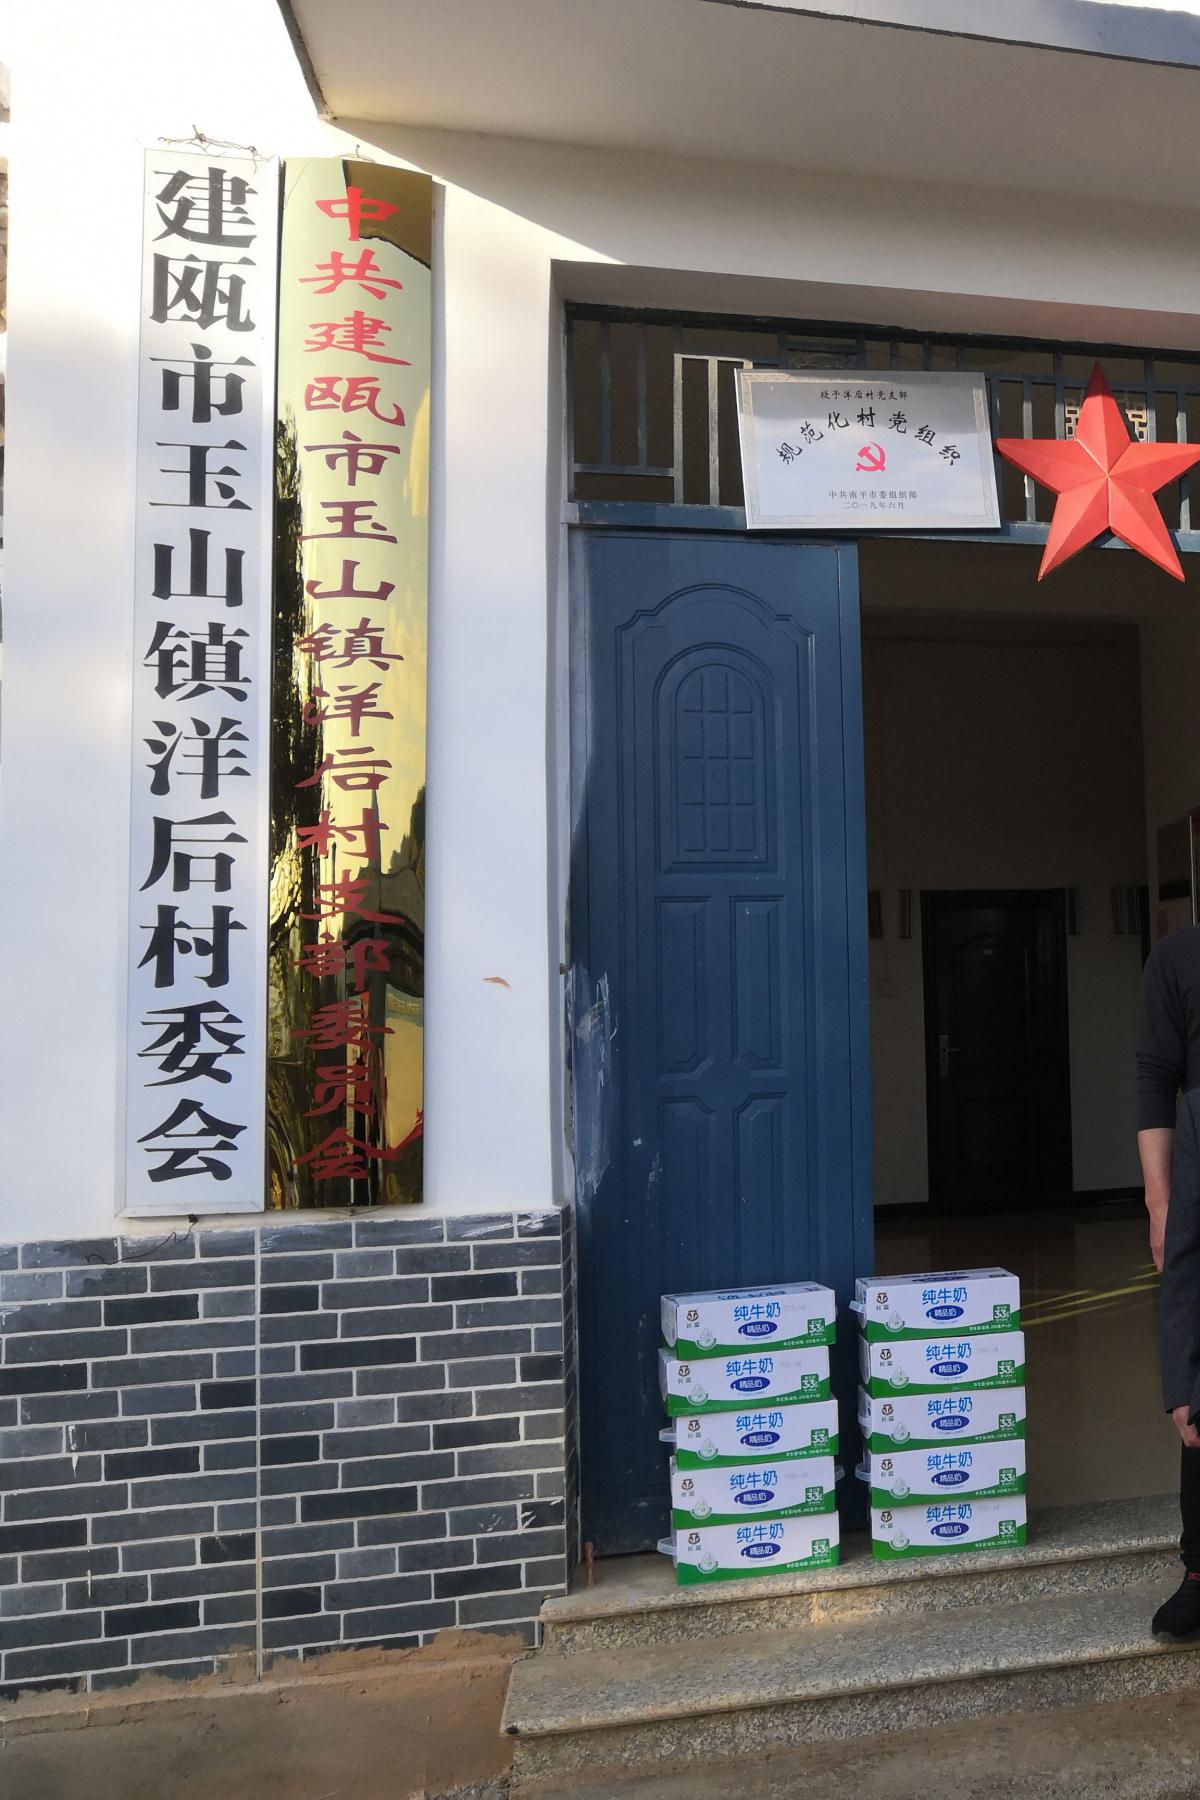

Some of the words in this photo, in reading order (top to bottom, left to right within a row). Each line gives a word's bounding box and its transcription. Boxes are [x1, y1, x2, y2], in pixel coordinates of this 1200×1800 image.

[819, 388, 908, 401] 授予洋后村党支部
[775, 406, 961, 466] 规范化村党组织
[828, 489, 919, 500] 中共南平市委组织部
[137, 167, 258, 1182] 建瓯市玉山镇洋后村委会
[291, 186, 412, 1179] 中共建瓯市玉山镇洋后村支部委员会
[922, 1287, 968, 1305] 纯牛奶
[735, 1302, 781, 1322] 纯牛奶
[926, 1343, 972, 1361] 纯牛奶
[726, 1358, 774, 1377] 纯牛奶
[927, 1397, 973, 1416] 纯牛奶
[736, 1412, 784, 1431] 纯牛奶
[927, 1452, 973, 1471] 纯牛奶
[730, 1470, 778, 1490] 纯牛奶
[926, 1504, 973, 1523] 纯牛奶
[736, 1523, 784, 1543] 纯牛奶
